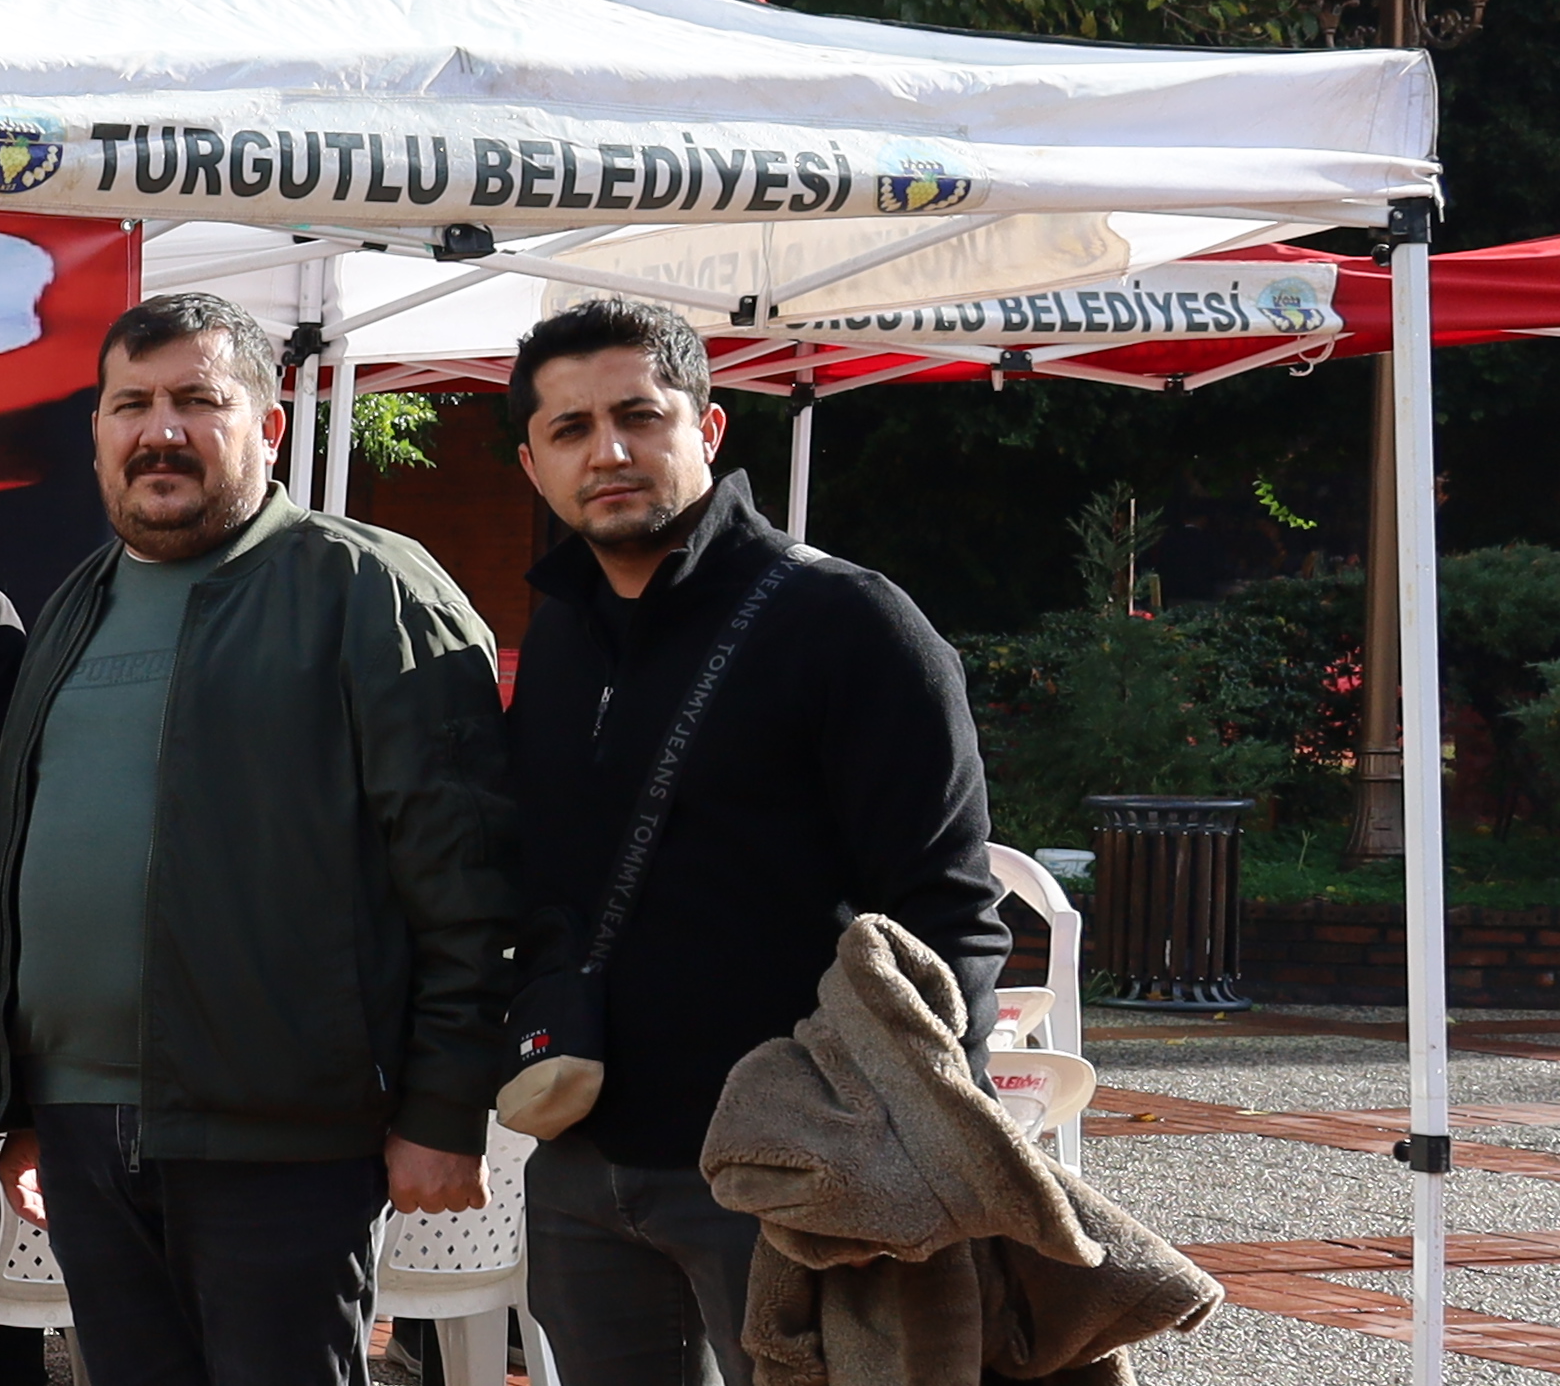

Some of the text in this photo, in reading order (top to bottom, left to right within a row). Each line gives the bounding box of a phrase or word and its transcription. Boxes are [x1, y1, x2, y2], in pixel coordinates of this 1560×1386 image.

[91, 121, 852, 214] TURGUTLU BELEDİYESİ
[1001, 278, 1250, 335] BELEDİYESİ
[730, 567, 786, 632] JEANS
[682, 642, 736, 724] TOMMY
[648, 722, 691, 800] JEANS
[614, 812, 660, 899] TOMMY
